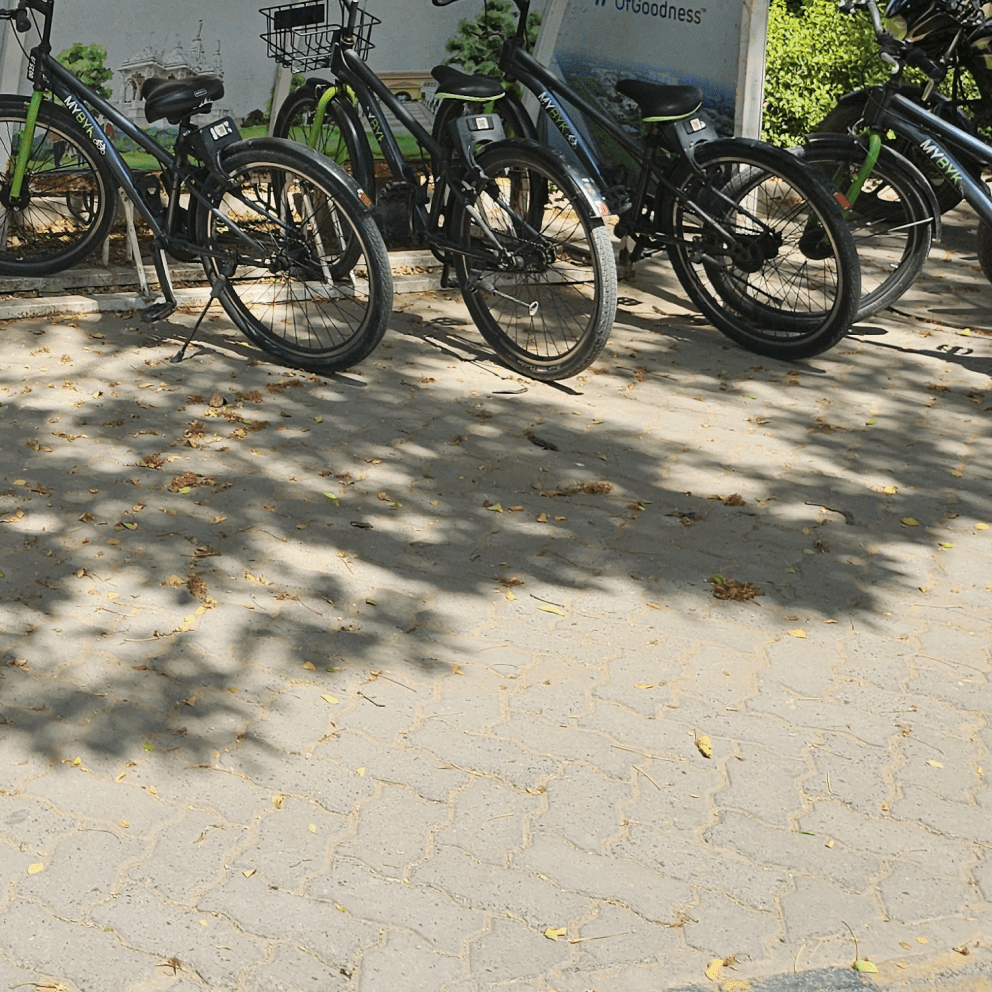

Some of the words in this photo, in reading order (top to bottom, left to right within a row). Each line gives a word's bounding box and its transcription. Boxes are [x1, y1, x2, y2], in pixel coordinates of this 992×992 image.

[64, 95, 94, 138] MYBYK
[538, 91, 568, 133] MYBYK
[920, 138, 963, 186] MYBYK
